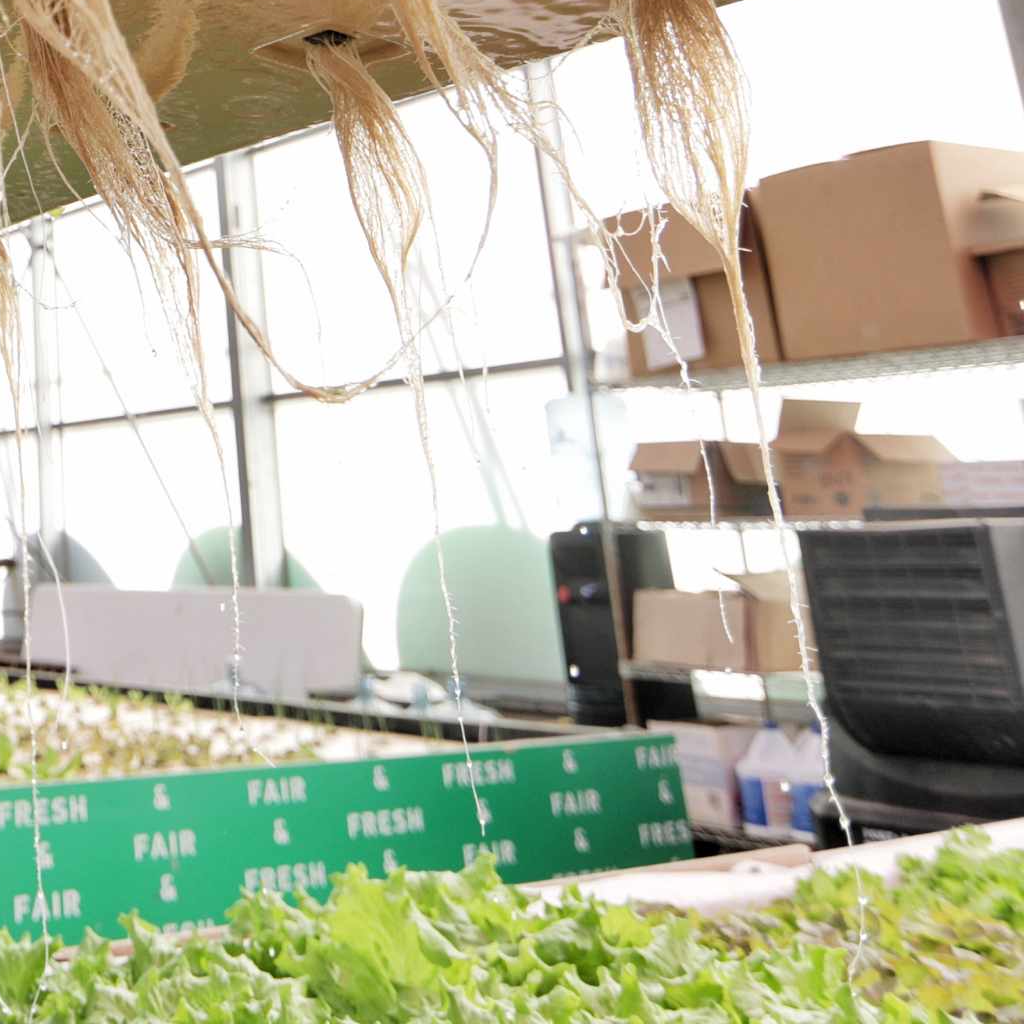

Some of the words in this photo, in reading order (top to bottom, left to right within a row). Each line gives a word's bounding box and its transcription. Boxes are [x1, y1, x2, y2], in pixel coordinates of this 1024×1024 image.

[442, 760, 515, 787] FRESH
[562, 749, 578, 773] &
[247, 775, 307, 806] FAIR
[372, 765, 390, 791] &
[658, 779, 674, 804] &
[153, 783, 171, 811] &
[549, 788, 602, 817] FAIR
[272, 818, 290, 845] &
[346, 807, 425, 838] FRESH
[638, 818, 691, 848] FRES
[133, 828, 197, 861] FAIR
[462, 839, 517, 870] FIR
[574, 827, 591, 853] &
[36, 840, 54, 870] &
[159, 873, 178, 902] &
[244, 861, 326, 895] FRESH
[13, 888, 82, 924] FAIR
